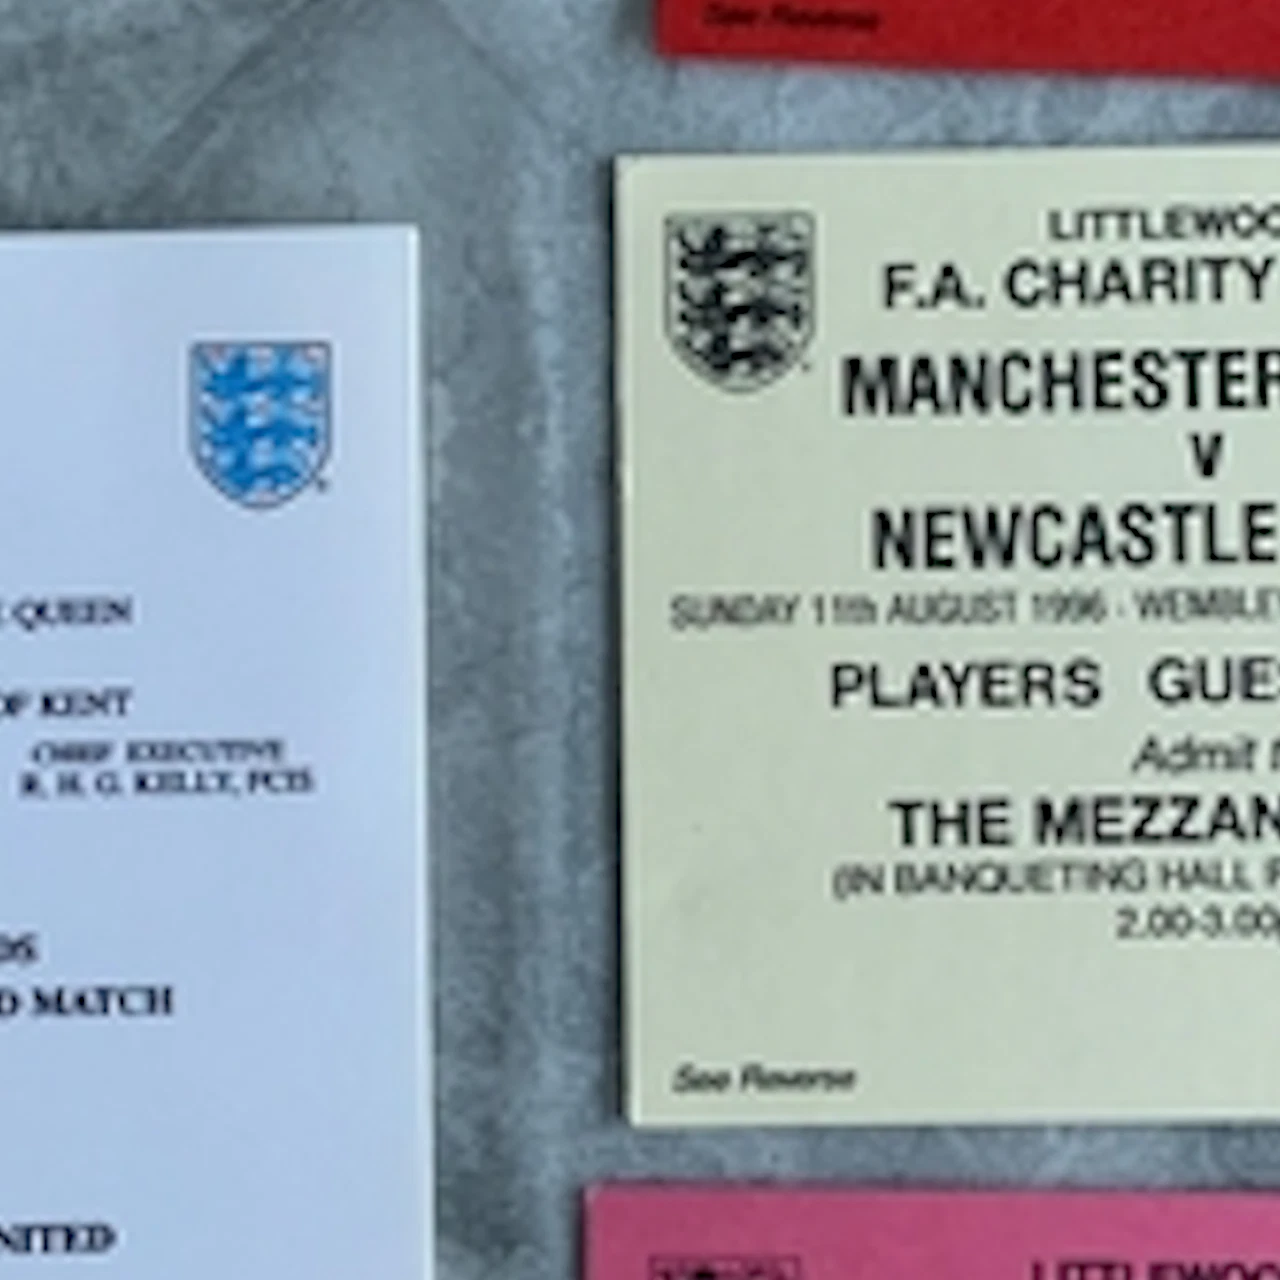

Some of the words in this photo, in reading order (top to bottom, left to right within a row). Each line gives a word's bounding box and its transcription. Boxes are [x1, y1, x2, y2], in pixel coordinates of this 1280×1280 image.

[884, 263, 985, 309] F.A.
[1003, 256, 1276, 309] CHARITY
[873, 502, 1277, 570] NEWCASTLE
[11, 598, 132, 633] QUEEN
[669, 594, 801, 631] SUNDAY
[812, 594, 878, 626] 11th
[886, 590, 1017, 626] AUGUST
[1031, 589, 1108, 624] 1996
[39, 688, 131, 718] KENT
[831, 658, 1102, 709] PLAYERS
[1130, 735, 1255, 777] Admit
[888, 797, 1012, 847] THE
[832, 864, 885, 901] (IN
[893, 856, 1149, 895] BANQUETING
[1157, 859, 1253, 893] HALL
[32, 985, 173, 1017] MATCH
[672, 1063, 732, 1094] See
[739, 1063, 857, 1092] Reverse
